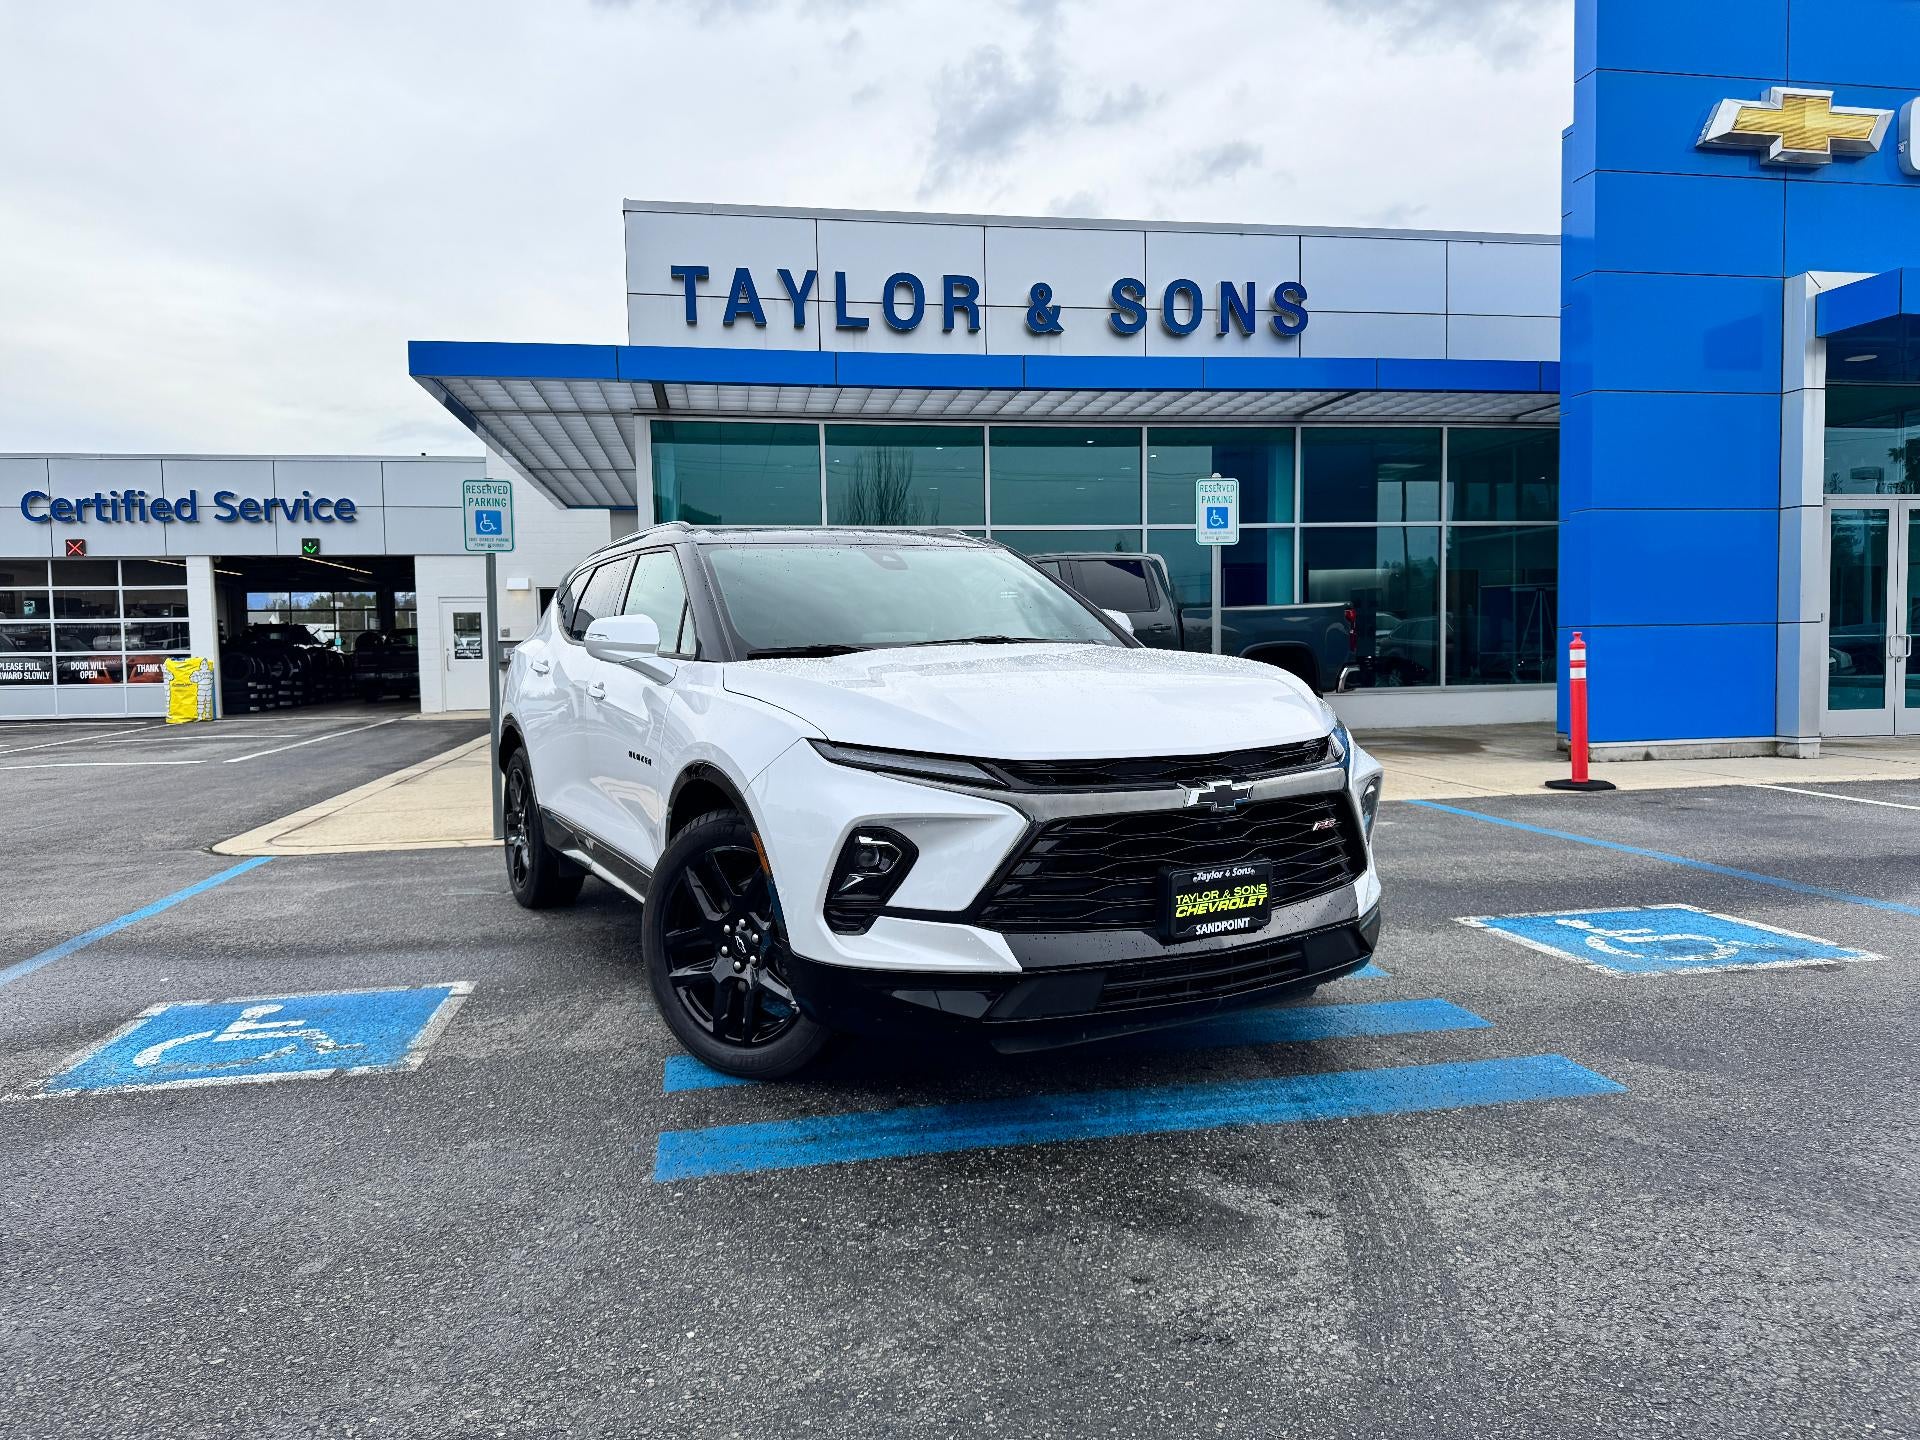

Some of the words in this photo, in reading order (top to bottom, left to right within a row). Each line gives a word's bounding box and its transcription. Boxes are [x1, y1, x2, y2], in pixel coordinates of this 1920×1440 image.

[670, 265, 981, 332] TAYLOR
[1024, 282, 1065, 335] &
[1107, 277, 1309, 336] SONS
[465, 484, 509, 495] RESERVED
[1199, 484, 1236, 493] RESERVED
[468, 497, 507, 508] PARKING
[1201, 495, 1233, 504] PARKING
[20, 489, 199, 524] Certified
[213, 490, 358, 524] Service
[0, 662, 23, 671] PLEASE
[24, 662, 41, 671] PULL
[70, 661, 89, 671] DOOR
[90, 661, 107, 670] WILL
[136, 663, 160, 673] THANK
[23, 671, 50, 680] SLOWLY
[79, 670, 98, 680] OPEN
[1196, 870, 1224, 882] Taylor
[1225, 869, 1231, 877] &
[1231, 866, 1252, 877] Sons
[1175, 890, 1220, 906] TAYLOR
[1222, 889, 1231, 900] &
[1233, 883, 1268, 896] SONS
[1175, 895, 1267, 918] CHEVROLET
[1195, 917, 1251, 936] SANDPOINT
